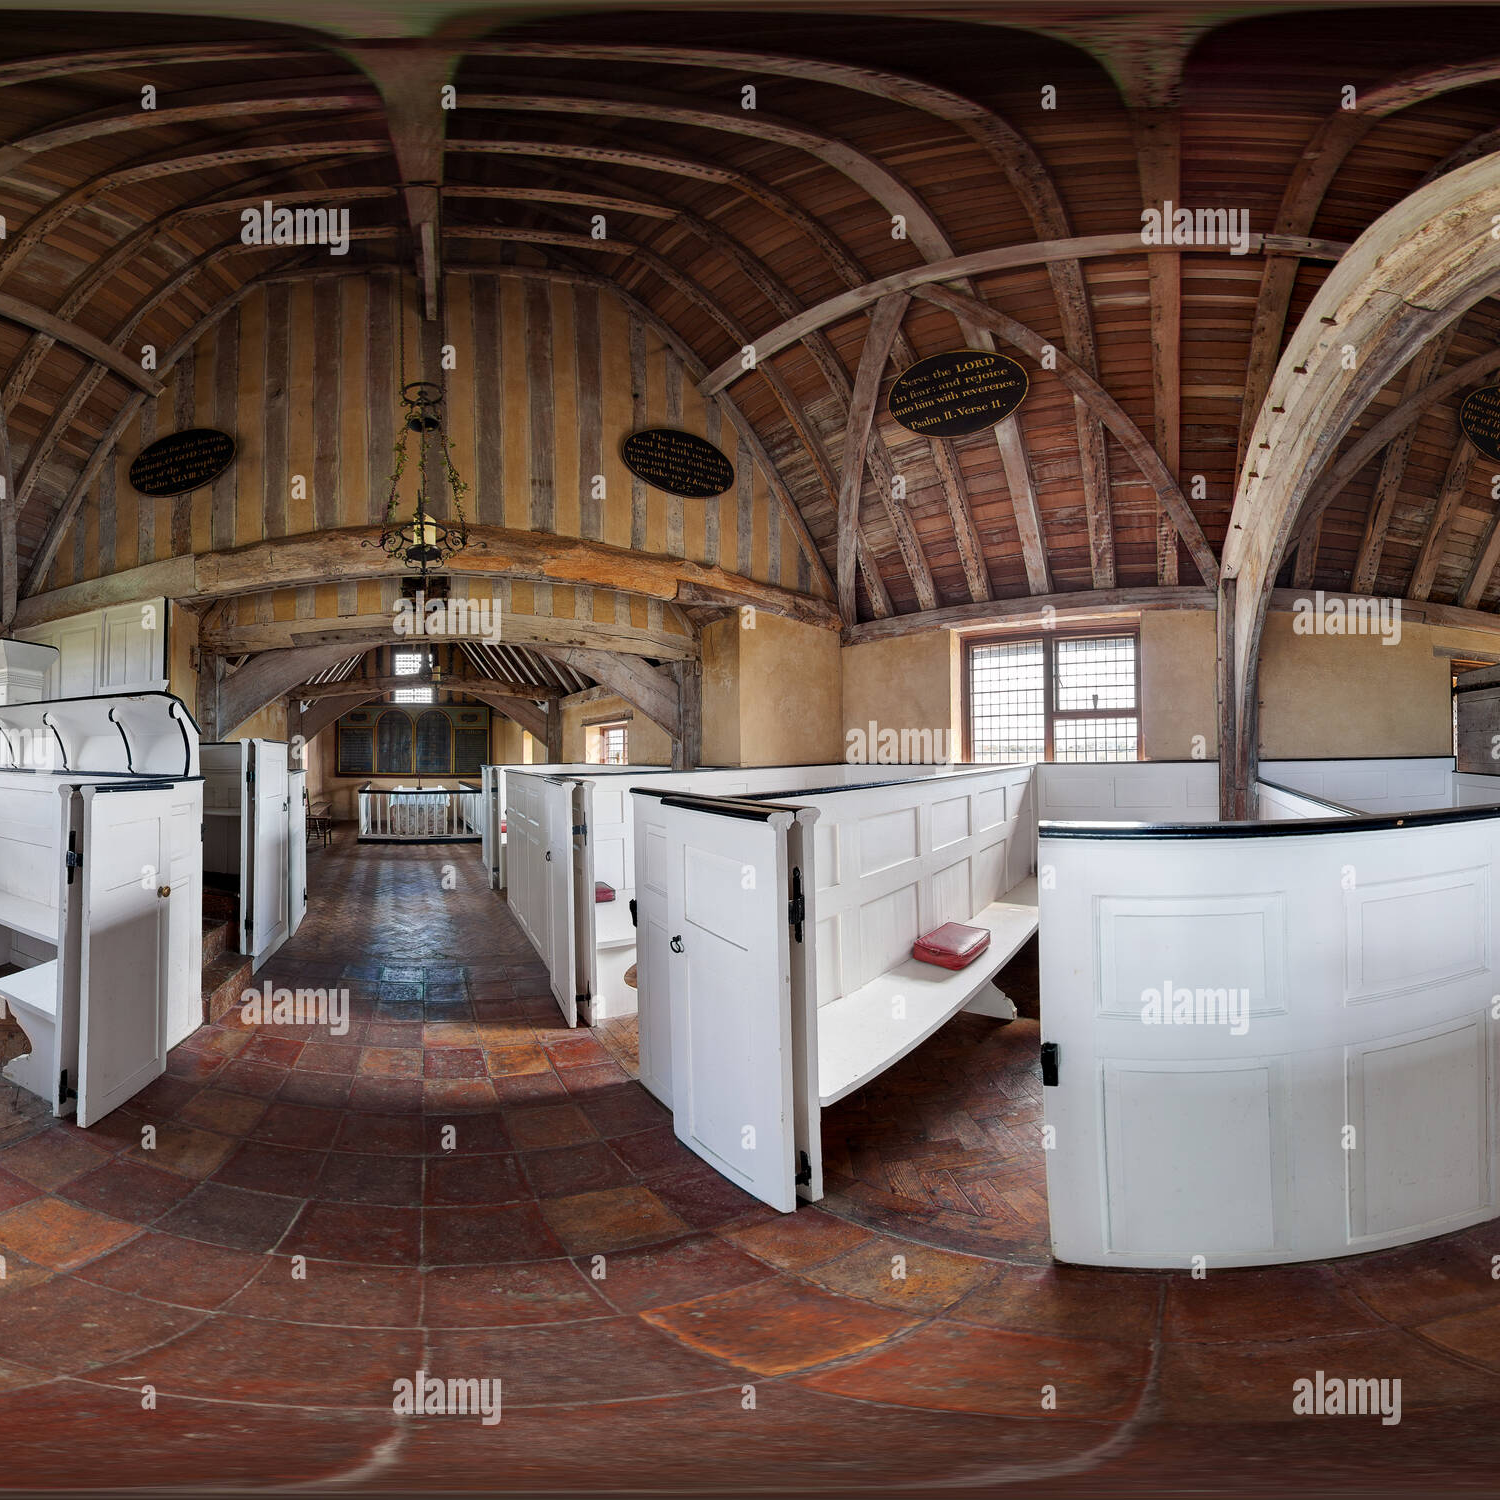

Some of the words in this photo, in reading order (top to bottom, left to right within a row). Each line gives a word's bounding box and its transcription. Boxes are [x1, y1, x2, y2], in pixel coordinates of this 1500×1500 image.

[894, 394, 908, 404] in
[938, 377, 960, 390] and
[965, 368, 1008, 384] rejoice
[900, 376, 930, 389] Serve
[932, 369, 952, 379] the
[956, 357, 995, 373] LORD
[892, 406, 914, 417] unto
[914, 399, 934, 410] him
[936, 391, 959, 404] with
[962, 380, 1020, 397] reverence.
[910, 416, 940, 430] Psalm
[956, 404, 988, 416] Verse
